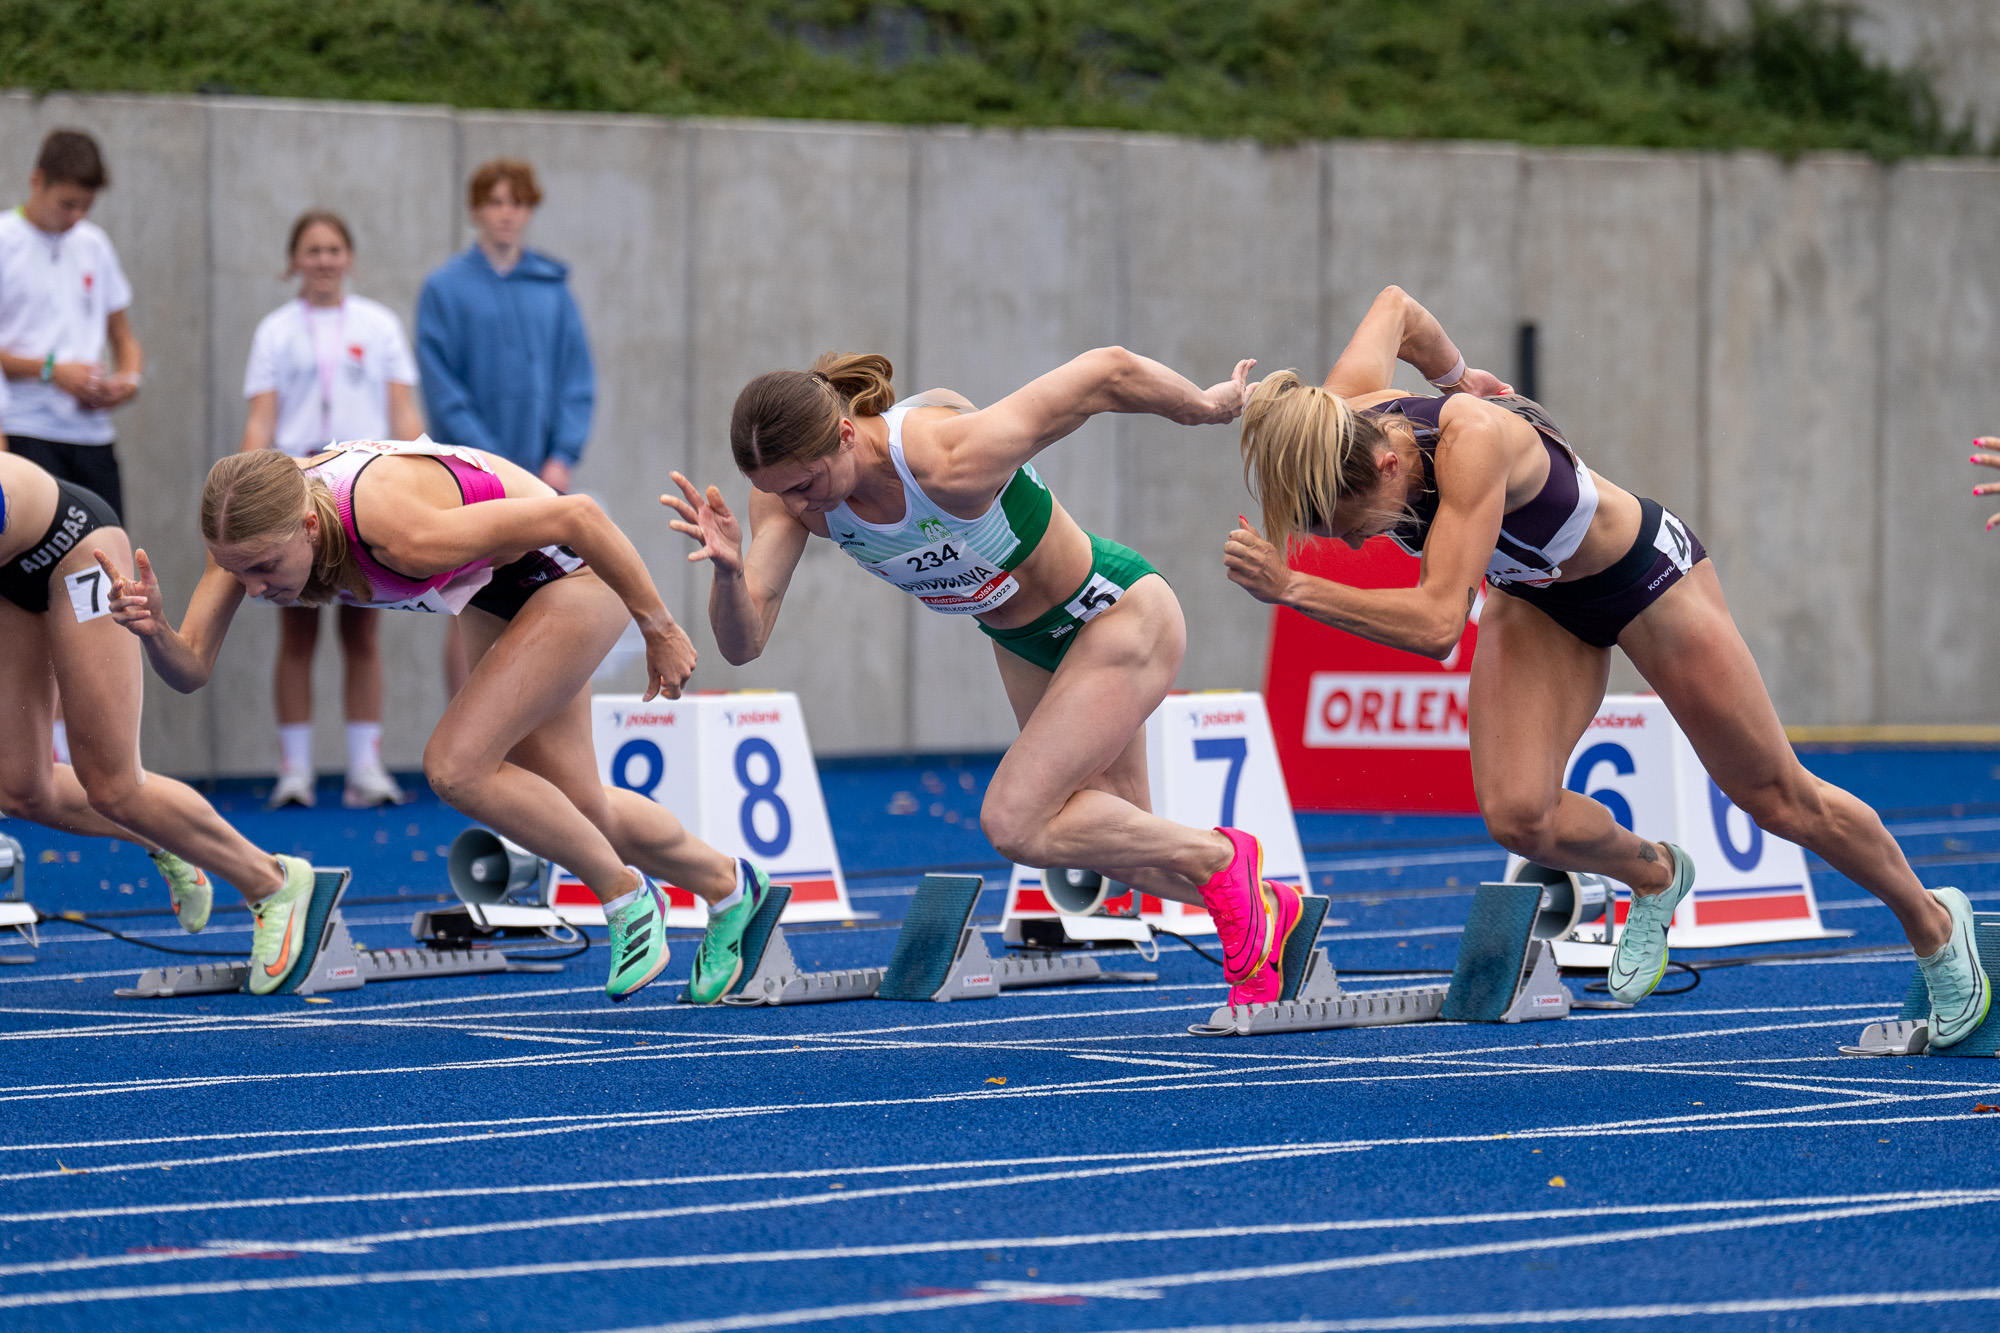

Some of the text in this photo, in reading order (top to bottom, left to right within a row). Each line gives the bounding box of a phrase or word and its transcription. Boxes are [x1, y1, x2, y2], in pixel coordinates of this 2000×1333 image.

[907, 543, 960, 573] 234
[1665, 520, 1690, 561] 4
[76, 570, 101, 614] 7
[992, 584, 1011, 602] 2023
[1079, 585, 1117, 611] 5
[625, 711, 676, 728] polanik
[737, 710, 781, 727] polanik
[1202, 711, 1246, 729] polanik
[1322, 689, 1469, 732] ORLEN
[735, 737, 792, 858] 8
[1193, 738, 1247, 828] 7
[1567, 742, 1636, 832] 6
